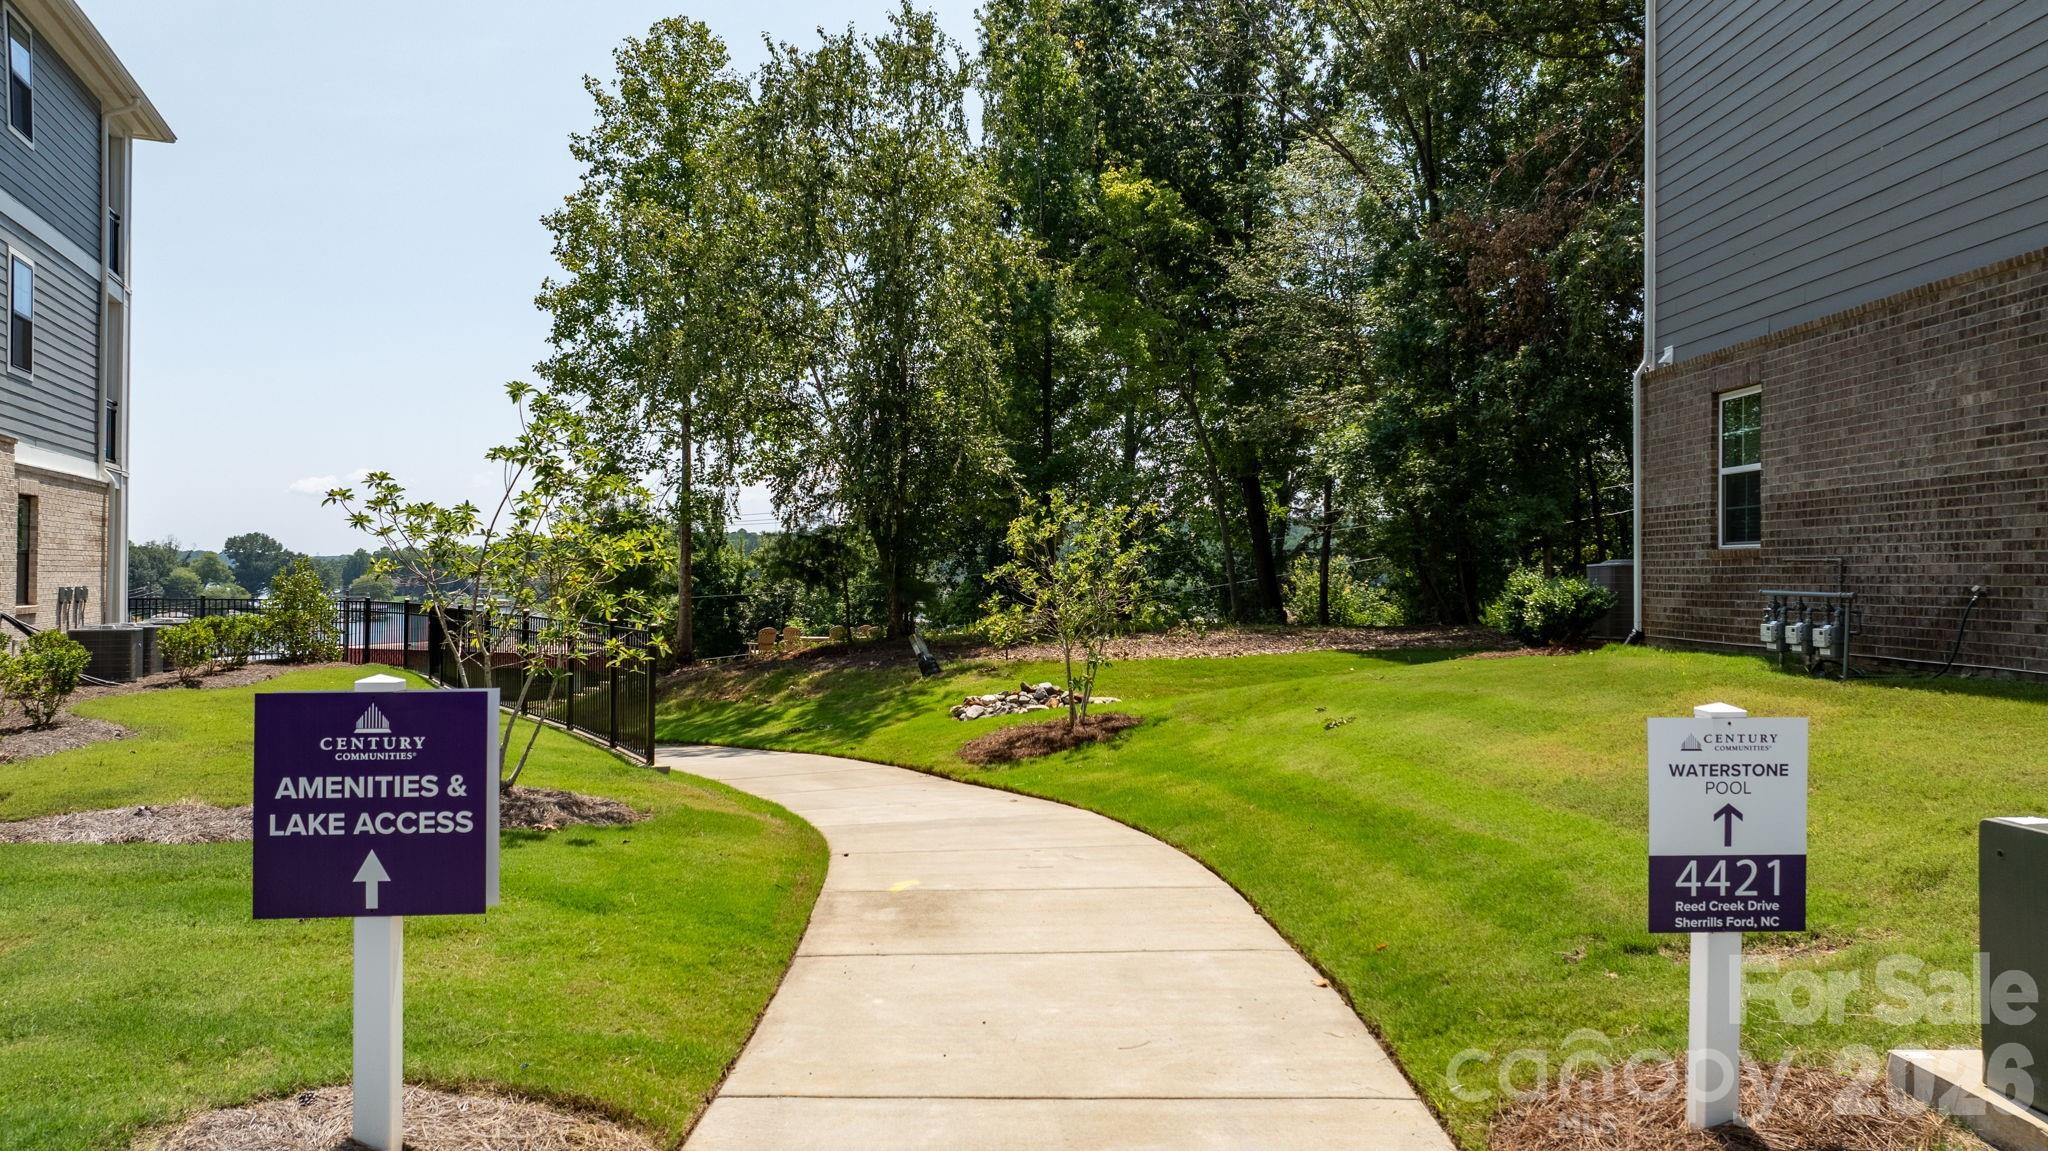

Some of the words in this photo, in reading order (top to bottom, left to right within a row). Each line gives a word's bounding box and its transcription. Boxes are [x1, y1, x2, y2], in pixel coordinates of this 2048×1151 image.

[320, 736, 426, 751] CENTURY
[1703, 733, 1778, 744] CENTURY
[1669, 763, 1789, 777] WATERSTONE
[275, 775, 439, 799] AMENITIES
[446, 774, 467, 797] &
[1705, 781, 1752, 795] POOL
[269, 813, 345, 836] LAKE
[353, 811, 474, 835] ACCESS
[1675, 859, 1781, 897] 4421
[1675, 901, 1706, 912] Reed
[1709, 900, 1745, 911] Creek
[1747, 900, 1780, 911] Drive
[1675, 917, 1723, 928] Sherrills
[1726, 917, 1758, 929] Ford,
[1760, 916, 1780, 927] NC
